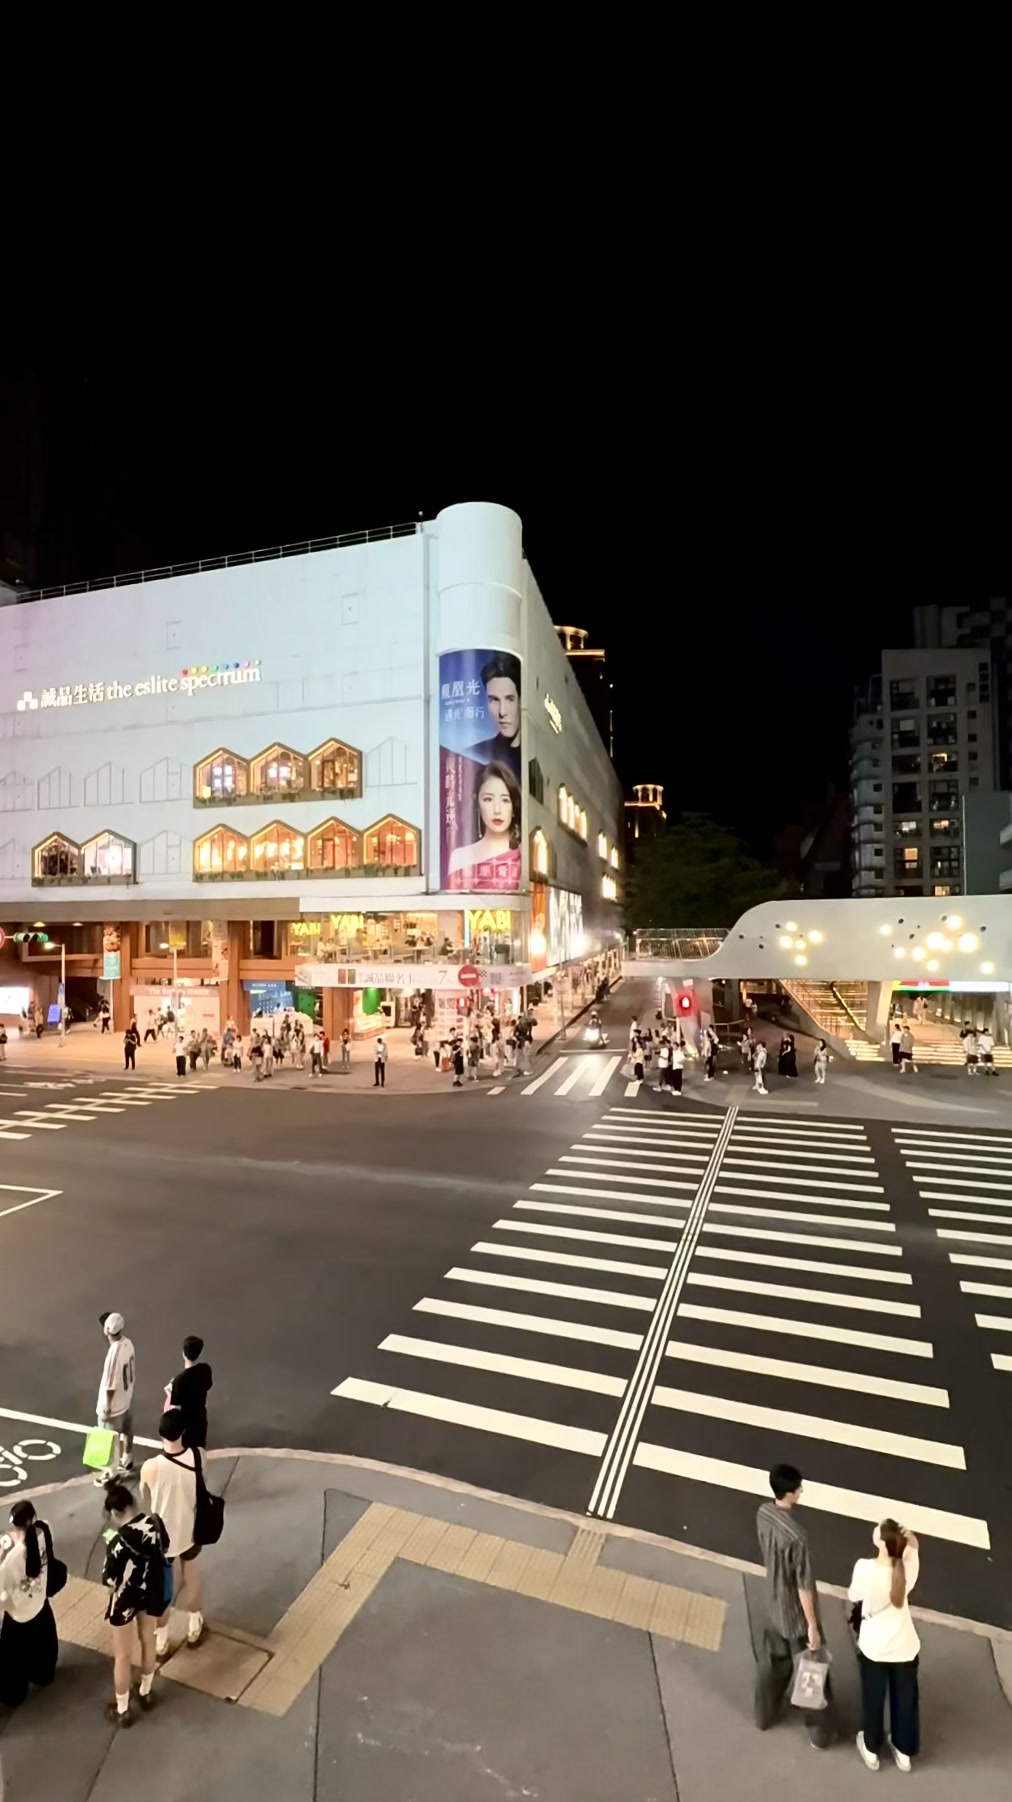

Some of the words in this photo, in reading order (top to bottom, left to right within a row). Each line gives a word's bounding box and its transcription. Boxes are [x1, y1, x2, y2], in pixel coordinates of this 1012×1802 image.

[41, 682, 104, 708] 誠品生活
[106, 680, 133, 699] the
[134, 675, 178, 696] eslite
[180, 668, 261, 696] spectrum
[330, 914, 363, 929] YABI
[468, 909, 511, 930] YABI
[292, 922, 320, 936] YABI
